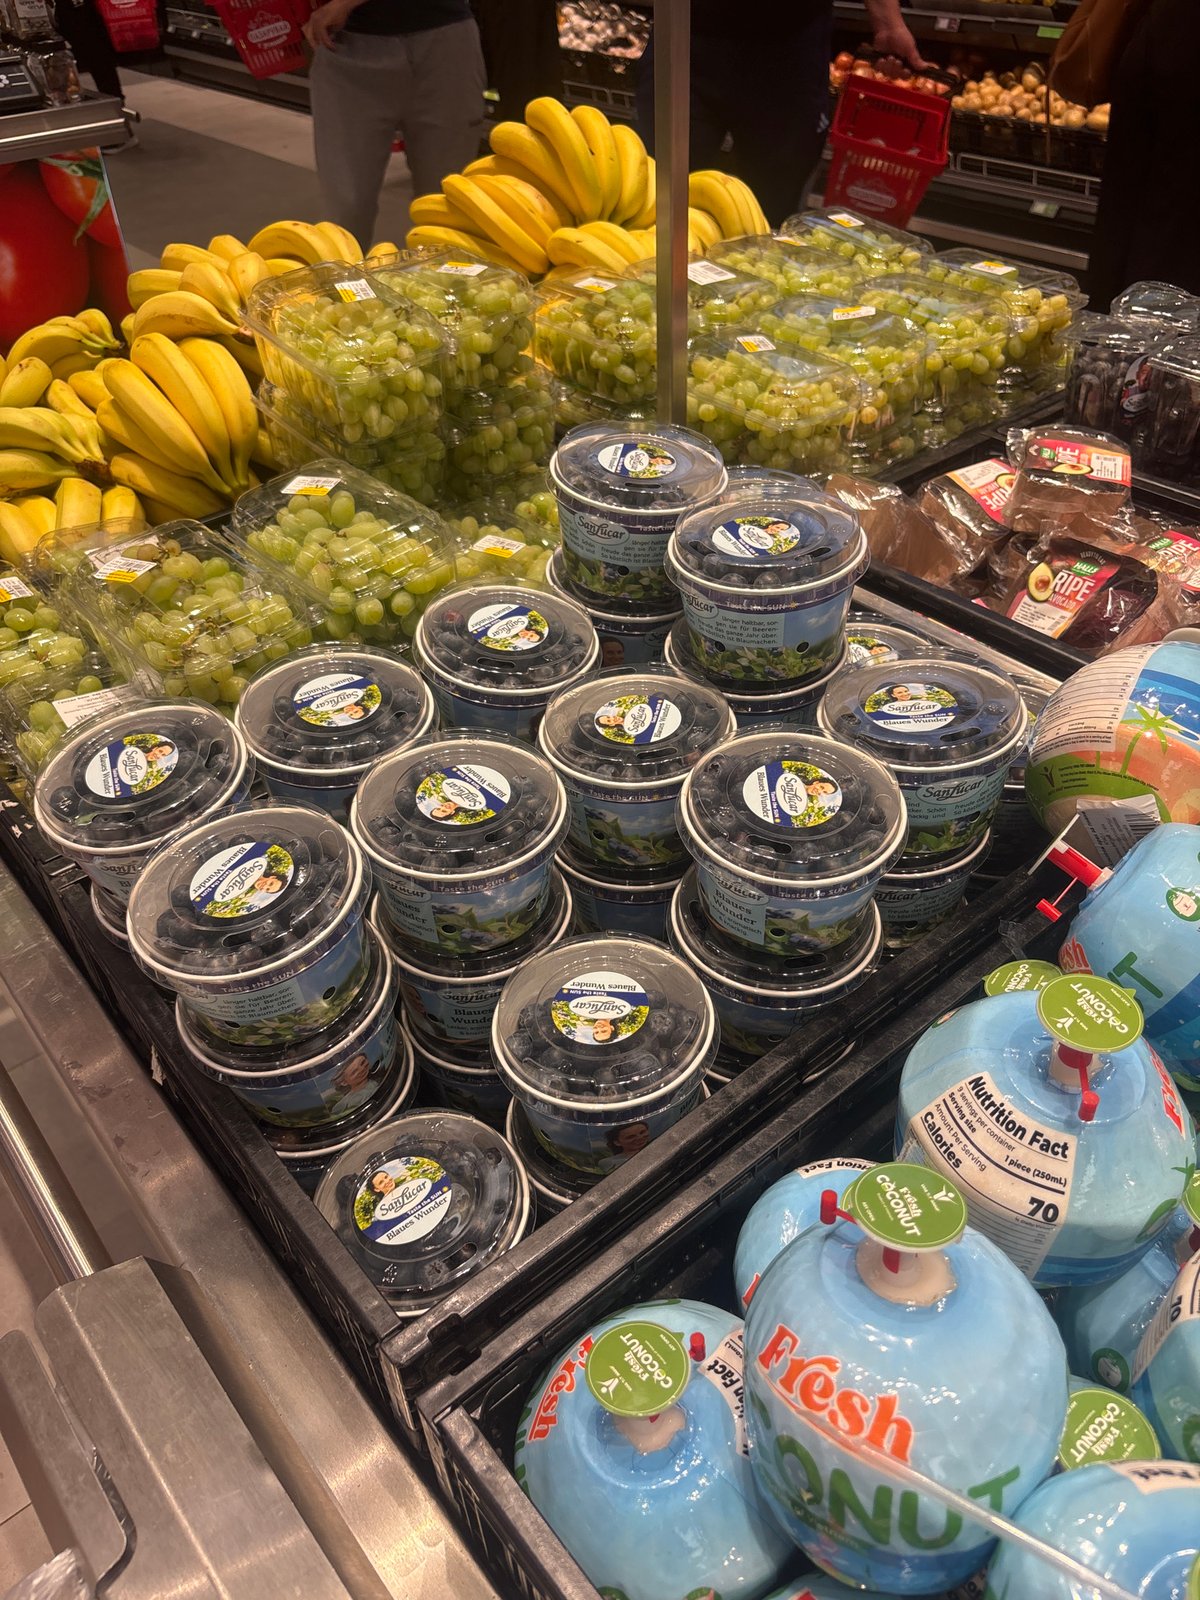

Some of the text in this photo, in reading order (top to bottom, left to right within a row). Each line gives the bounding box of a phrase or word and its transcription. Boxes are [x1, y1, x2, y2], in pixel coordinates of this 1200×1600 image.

[577, 515, 626, 541] SanLucar
[1073, 561, 1099, 574] HALLS
[1050, 570, 1095, 602] RIPE
[492, 617, 526, 638] SanLucar
[298, 685, 330, 698] Wunder
[315, 689, 360, 710] SanLucar
[887, 701, 938, 714] SanLucar
[628, 705, 647, 733] SanLucar
[913, 716, 949, 724] Wunder
[121, 750, 143, 782] SanLucar
[463, 765, 507, 799] Blaues Wunder
[445, 780, 482, 808] SanLucar
[757, 771, 771, 818] Blaues Wunder
[780, 776, 803, 813] SanLucar
[922, 780, 984, 802] SanLucar
[192, 846, 248, 895] Blaues Wunder
[219, 860, 264, 901] SanLucar
[467, 883, 484, 892] the
[486, 877, 506, 889] SUN
[714, 888, 752, 916] Blaues
[828, 885, 849, 895] SUN
[712, 894, 758, 926] Wunder
[570, 980, 637, 992] Blaues Wunder
[572, 999, 627, 1015] SanLucar
[1070, 982, 1129, 1034] COCONUT
[1077, 996, 1106, 1025] Fresh
[948, 1091, 977, 1135] Serving size
[957, 1085, 1017, 1152] 9 servings per container
[968, 1075, 1069, 1160] Nutrition Fact
[923, 1110, 964, 1170] Calories
[934, 1103, 988, 1173] Amount Per Serving
[804, 1160, 833, 1173] Fact
[1004, 1154, 1068, 1189] 1 piece (250mL)
[379, 1180, 428, 1217] SanLucar
[406, 1204, 422, 1216] Taste
[430, 1190, 443, 1201] SUN
[875, 1174, 922, 1237] COCONUT
[898, 1186, 924, 1219] Fresh
[1027, 1195, 1060, 1224] 70
[385, 1196, 448, 1242] Blaues Wunder
[620, 1333, 673, 1389] COCONUT
[624, 1350, 650, 1382] Fresh
[706, 1359, 740, 1389] Fact
[757, 1323, 916, 1466] Fresh
[1070, 1402, 1121, 1464] COCONUT
[1090, 1426, 1121, 1456] Fresh
